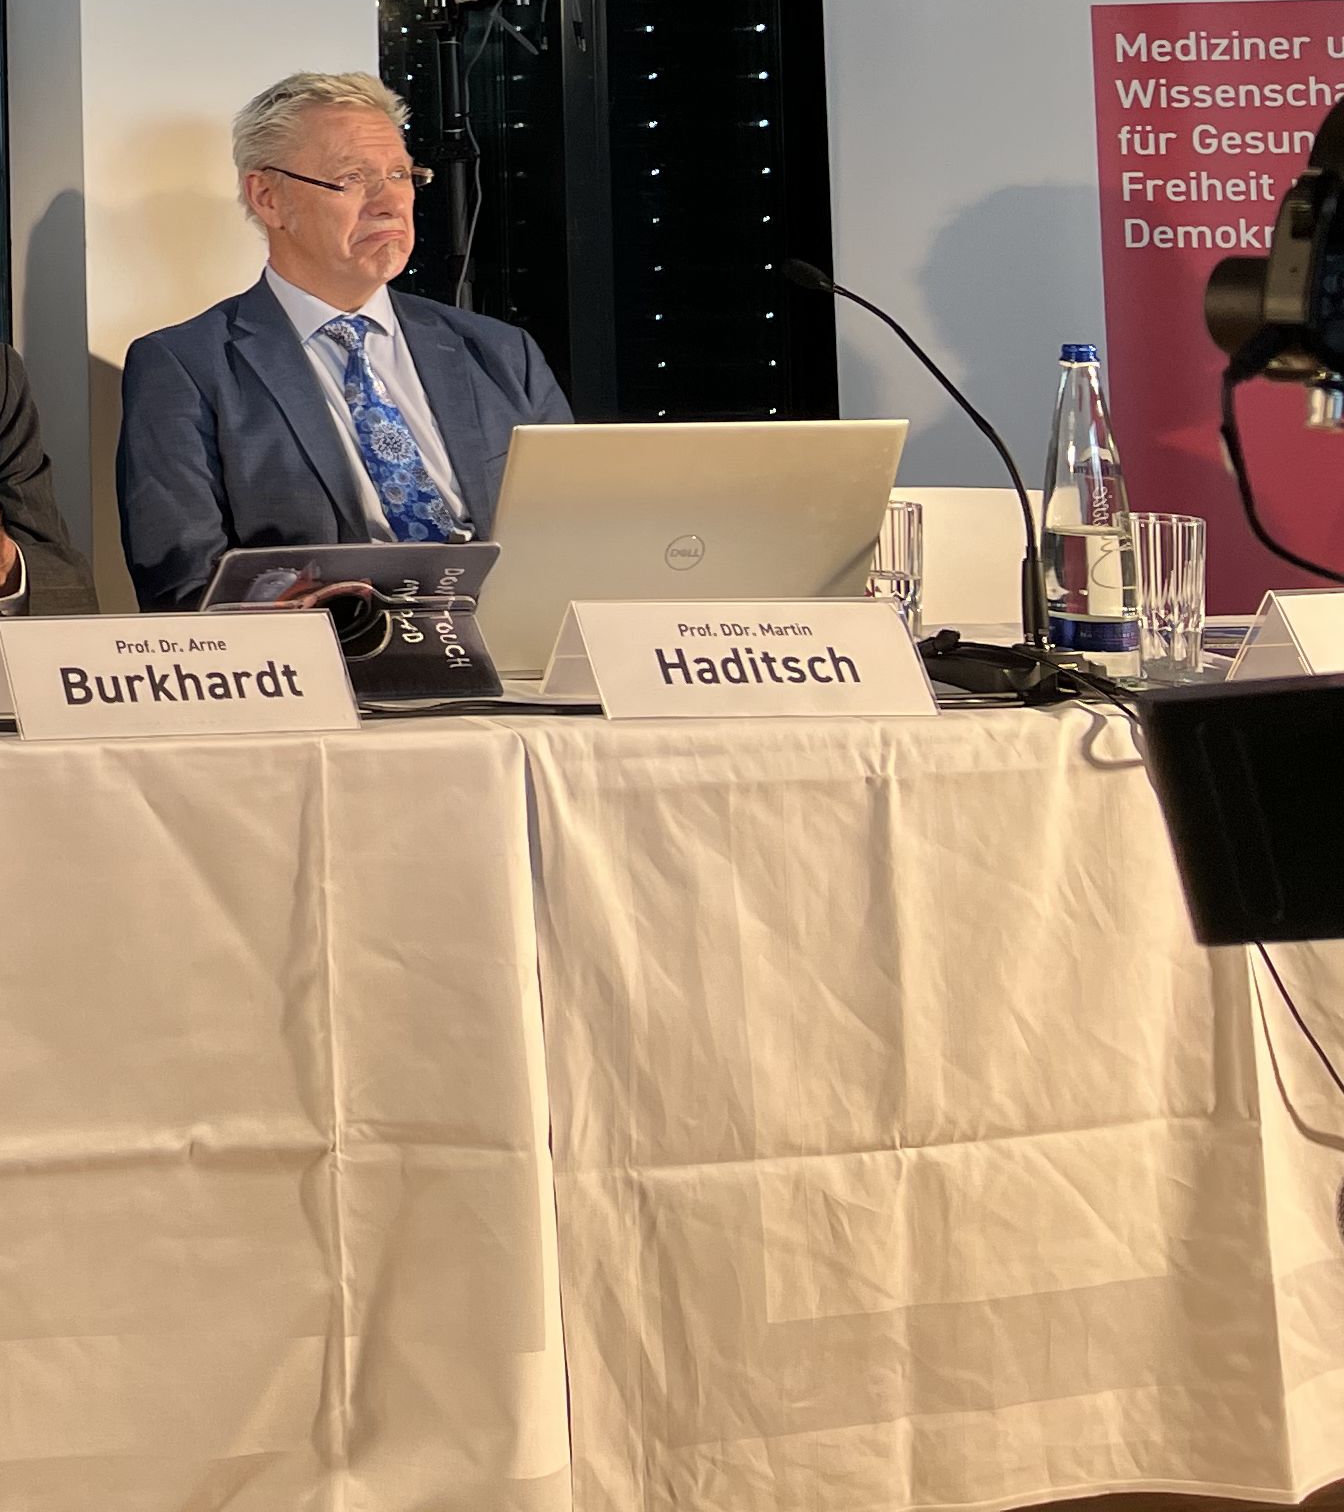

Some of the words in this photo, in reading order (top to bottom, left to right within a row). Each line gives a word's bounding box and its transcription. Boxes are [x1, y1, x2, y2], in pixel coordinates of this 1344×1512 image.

[1115, 30, 1311, 63] Mediziner
[1118, 124, 1178, 156] für
[1122, 170, 1275, 202] Freiheit
[670, 549, 699, 557] DELL
[115, 639, 156, 654] Prof.
[158, 639, 184, 653] Dr.
[188, 637, 227, 652] Arne
[430, 610, 472, 668] TOUCH
[677, 623, 718, 637] Prof.
[719, 623, 757, 637] DDr.
[759, 622, 813, 637] Martin
[654, 646, 861, 685] Haditsch
[59, 660, 304, 706] Burkhardt
